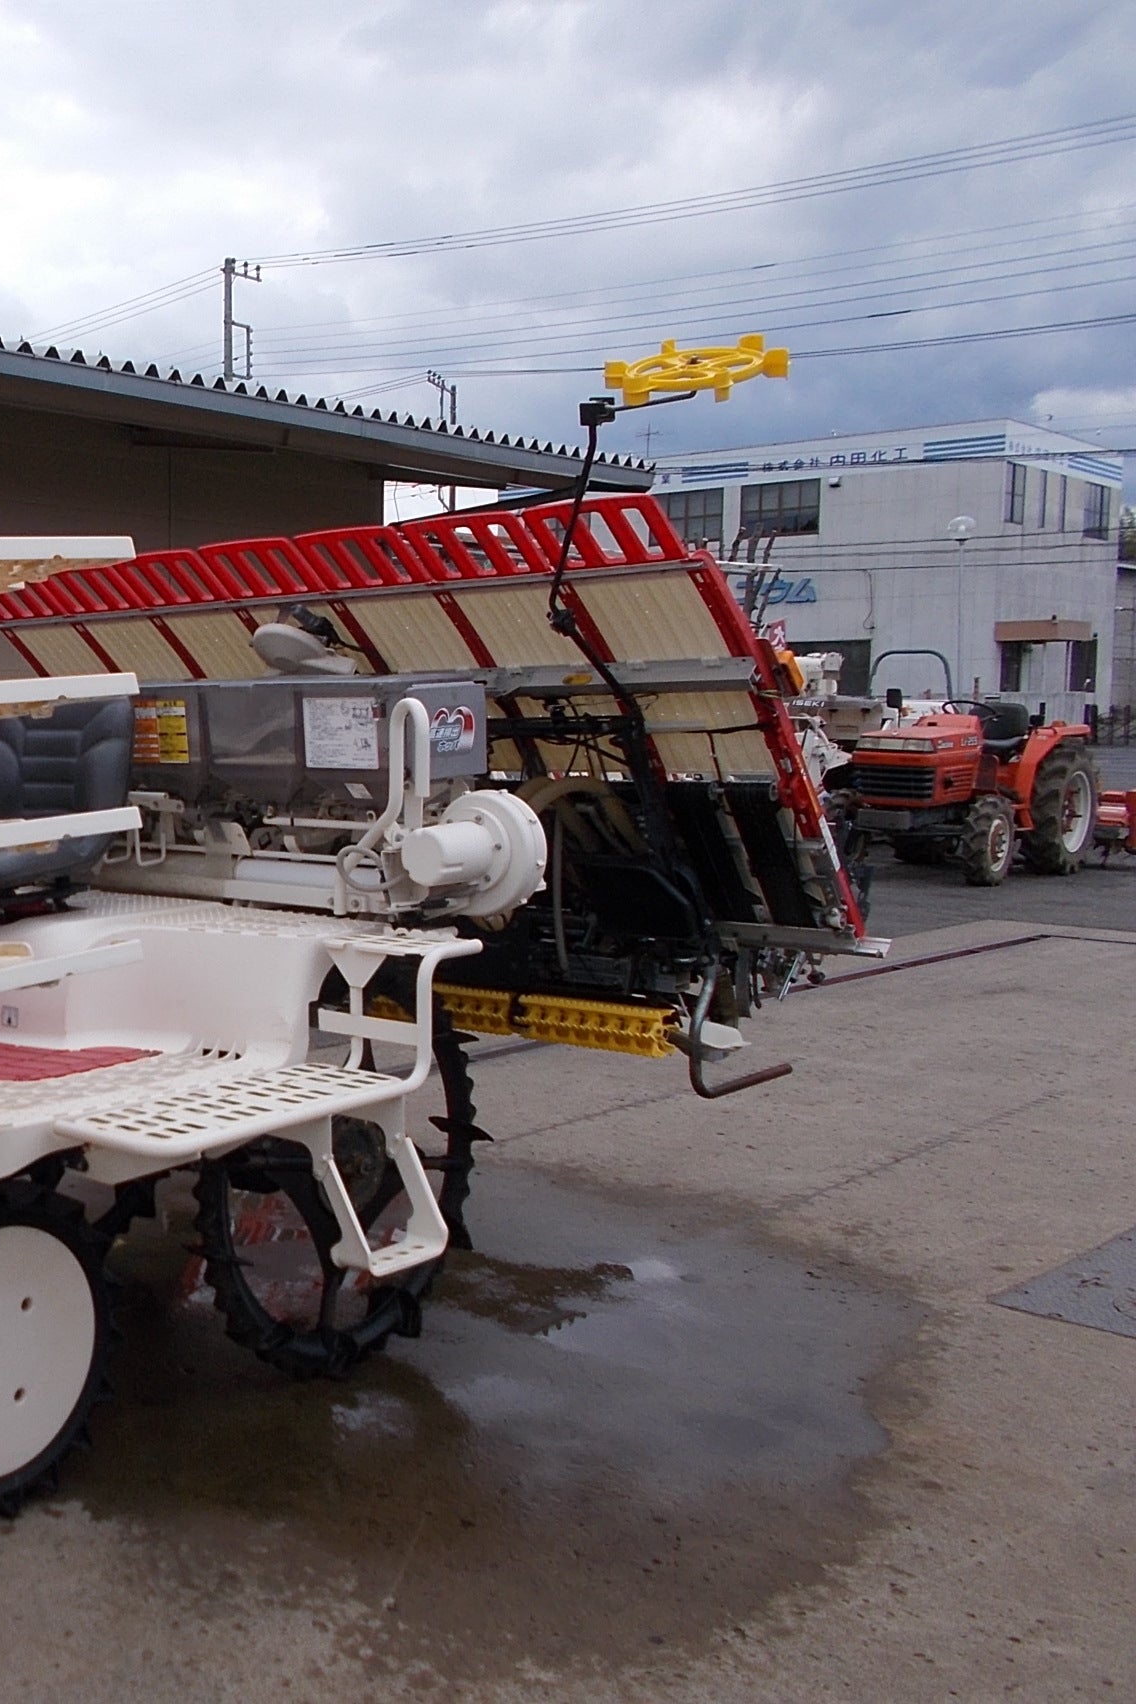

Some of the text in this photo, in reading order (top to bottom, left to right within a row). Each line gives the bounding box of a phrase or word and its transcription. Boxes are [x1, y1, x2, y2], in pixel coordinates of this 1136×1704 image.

[830, 447, 908, 466] 内田化工
[771, 625, 785, 650] 大
[792, 699, 825, 708] ISEKI
